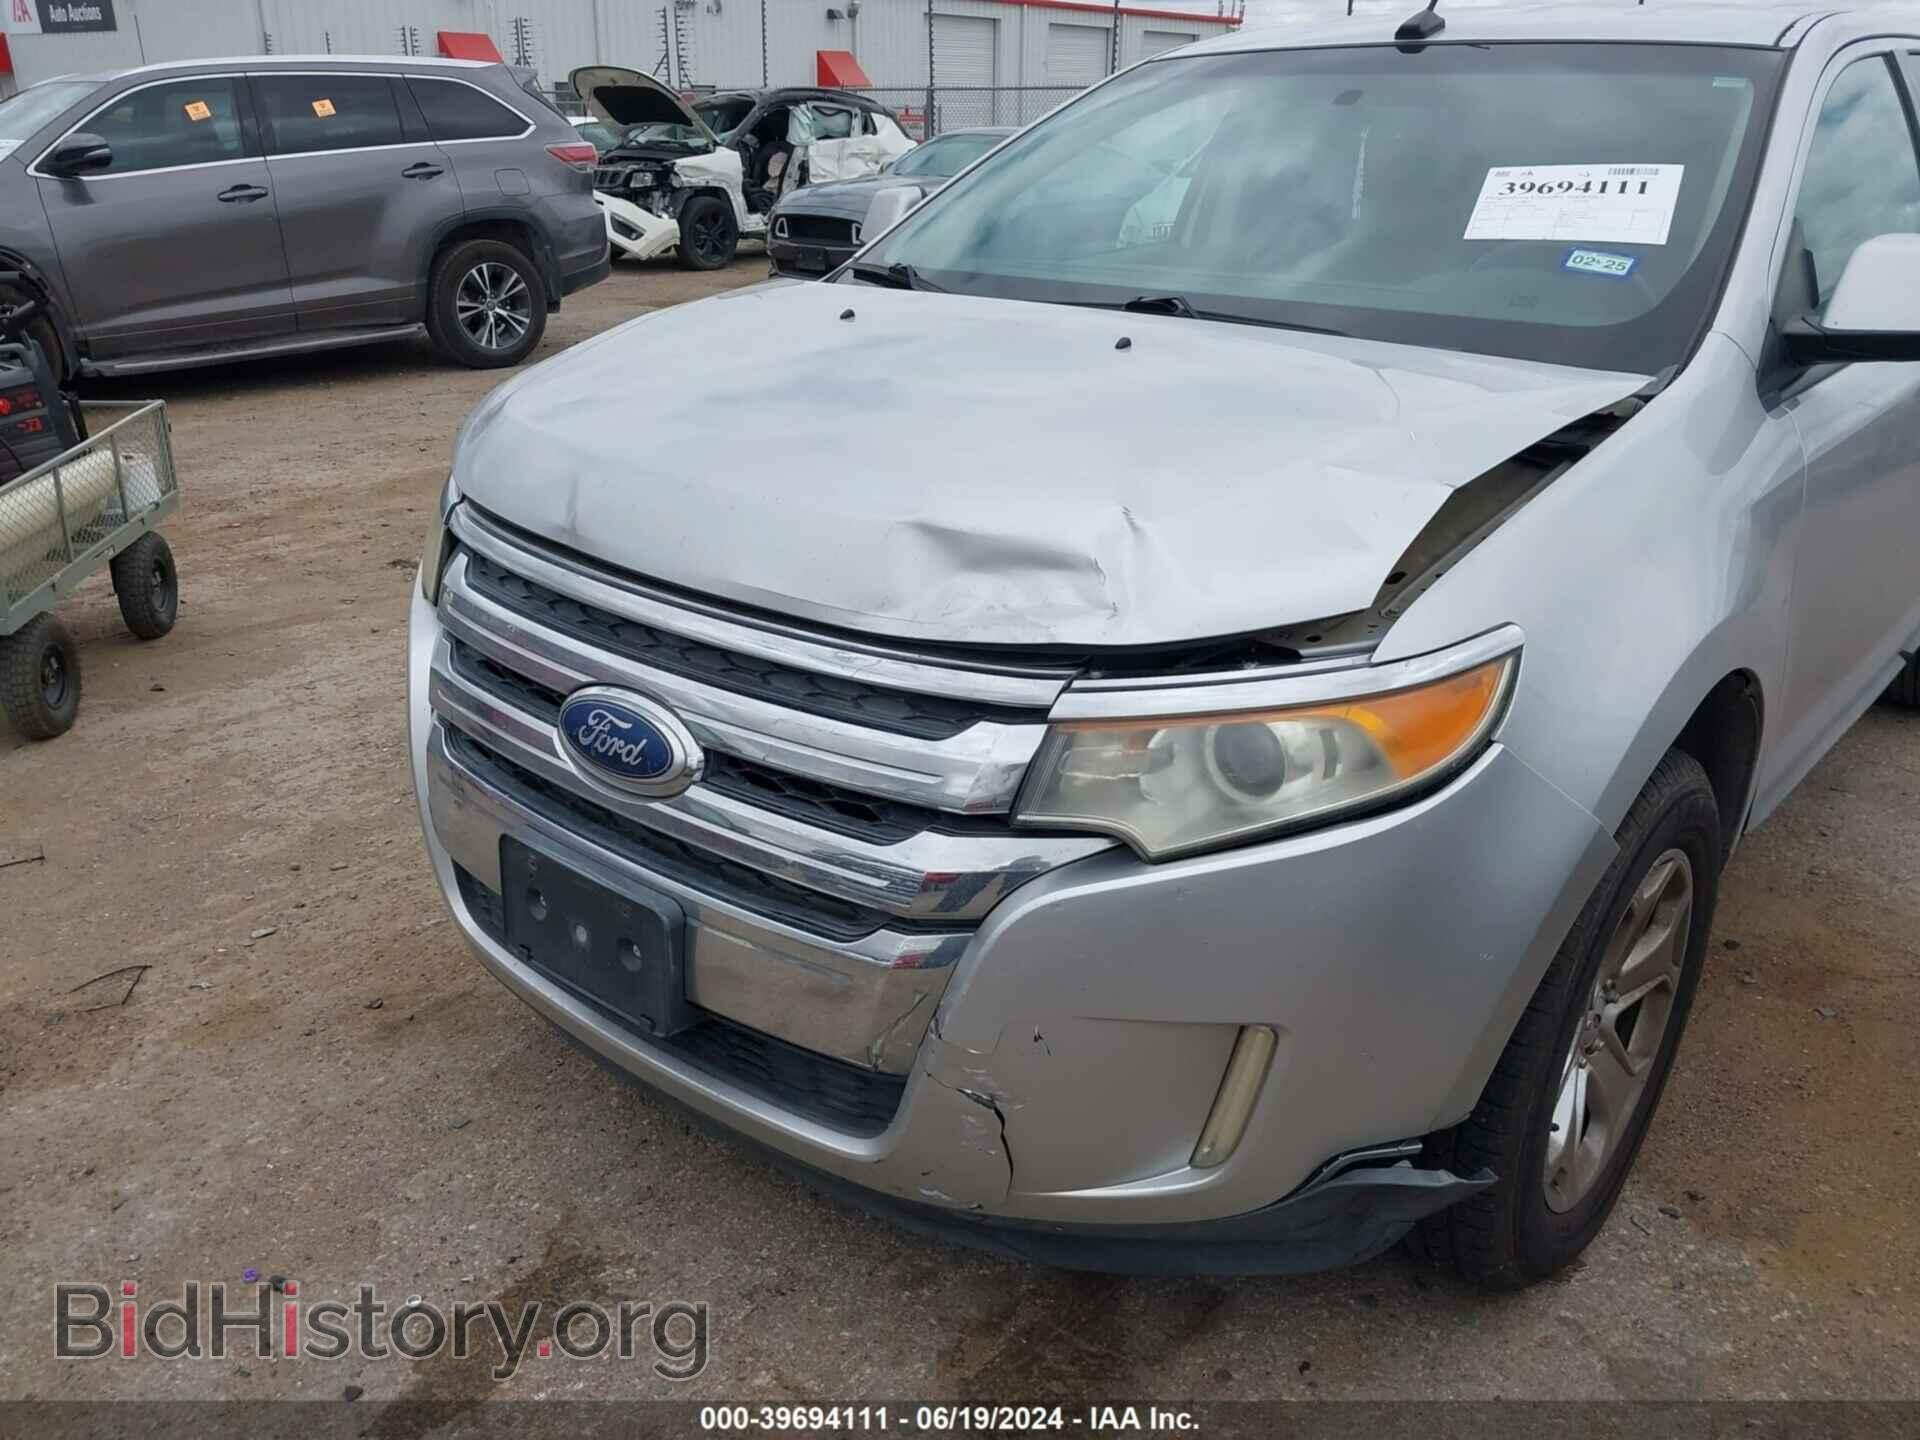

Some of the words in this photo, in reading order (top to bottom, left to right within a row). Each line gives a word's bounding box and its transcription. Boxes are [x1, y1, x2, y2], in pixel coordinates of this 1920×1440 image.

[48, 4, 68, 22] Auto
[67, 2, 102, 22] Auctions
[1498, 180, 1649, 196] 39694111
[578, 709, 649, 766] Ford
